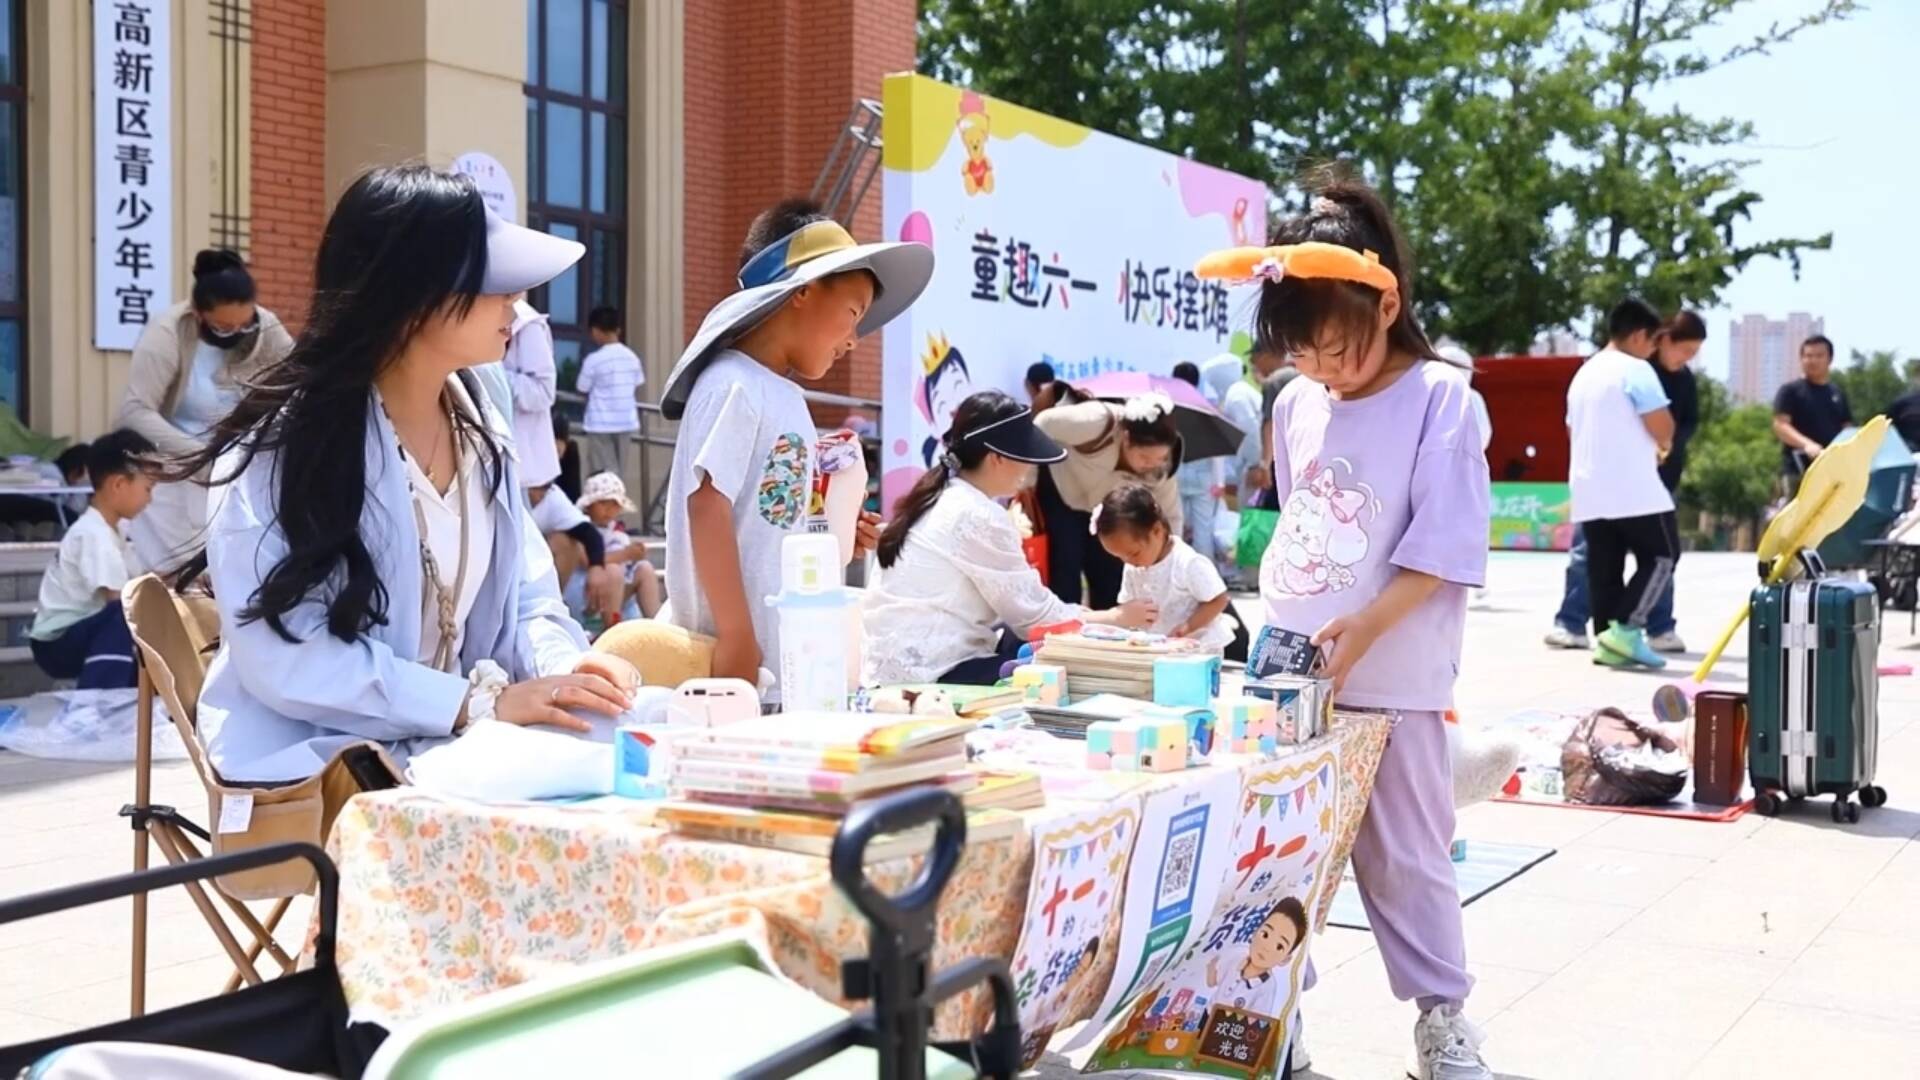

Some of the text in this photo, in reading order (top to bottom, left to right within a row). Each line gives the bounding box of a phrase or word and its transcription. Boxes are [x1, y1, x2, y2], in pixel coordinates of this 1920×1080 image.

[113, 1, 154, 325] 高新区青少年宫
[971, 228, 1229, 344] 童趣六一 快乐摆摊
[1236, 825, 1307, 890] 十一
[1250, 871, 1272, 892] 的
[1042, 875, 1095, 936] 十一
[1214, 1021, 1245, 1040] 欢迎
[1218, 1040, 1249, 1060] 光临
